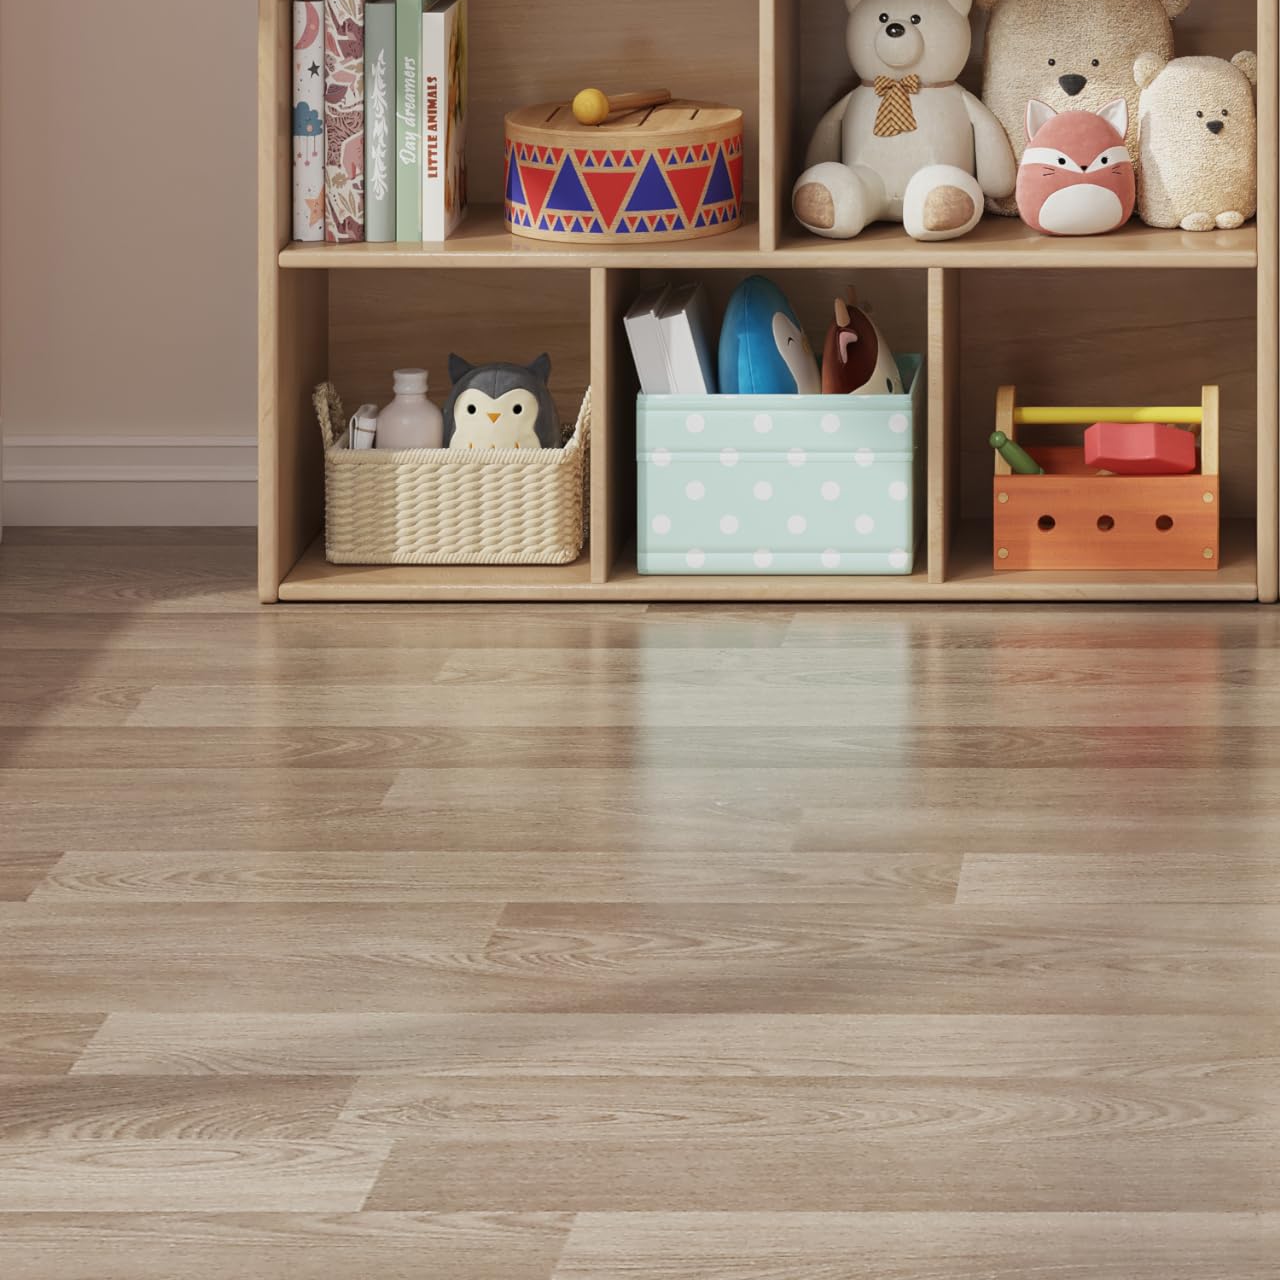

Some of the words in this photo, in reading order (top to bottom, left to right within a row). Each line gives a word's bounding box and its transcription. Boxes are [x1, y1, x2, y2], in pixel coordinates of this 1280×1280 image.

[396, 56, 416, 127] dreamers
[426, 76, 438, 132] ANIMALS
[399, 132, 422, 165] Day
[427, 135, 438, 179] LITTLE
